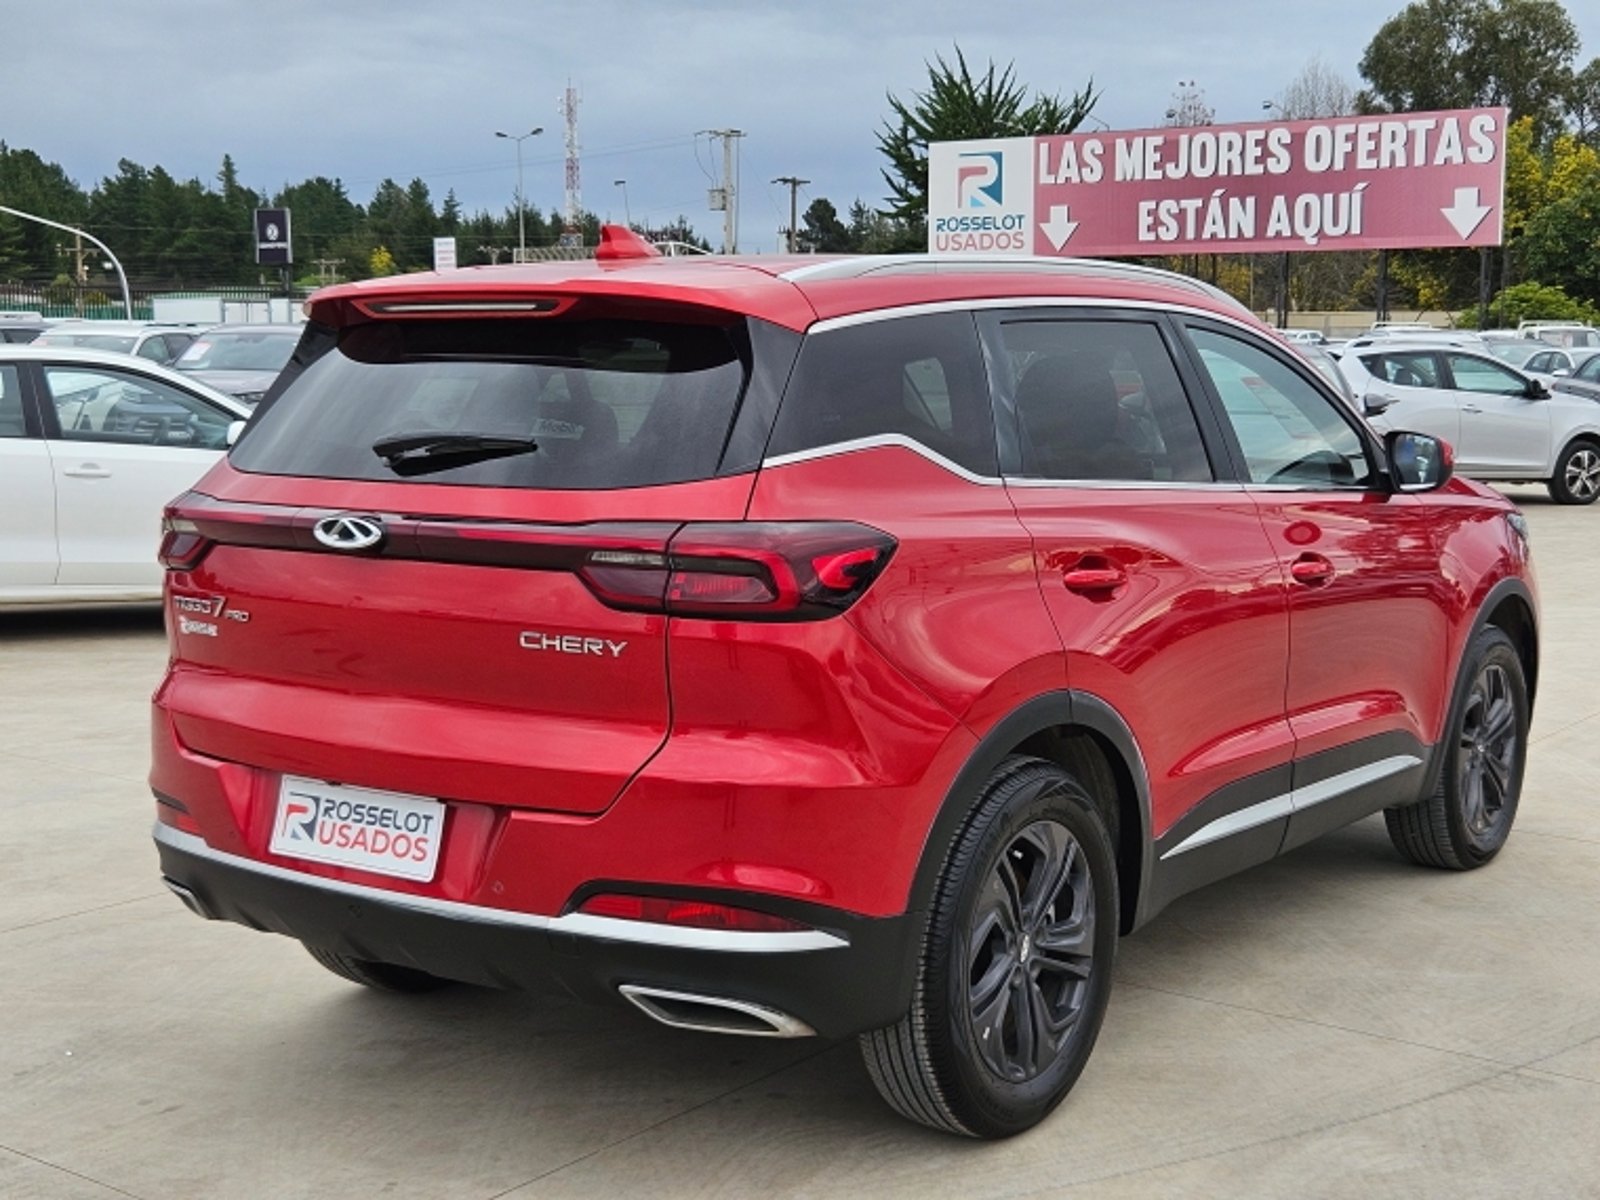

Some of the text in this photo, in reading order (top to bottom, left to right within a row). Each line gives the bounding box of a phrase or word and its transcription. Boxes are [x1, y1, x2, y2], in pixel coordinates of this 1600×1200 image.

[1039, 114, 1497, 185] LAS MEJORES OFERTAS
[936, 214, 1025, 232] ROSSELOT
[1138, 181, 1370, 246] ESTÁN AQUÍ
[936, 231, 1025, 251] USADOS
[519, 630, 628, 658] CHERY
[322, 798, 434, 835] ROSSELOT
[318, 820, 429, 862] USADOS
